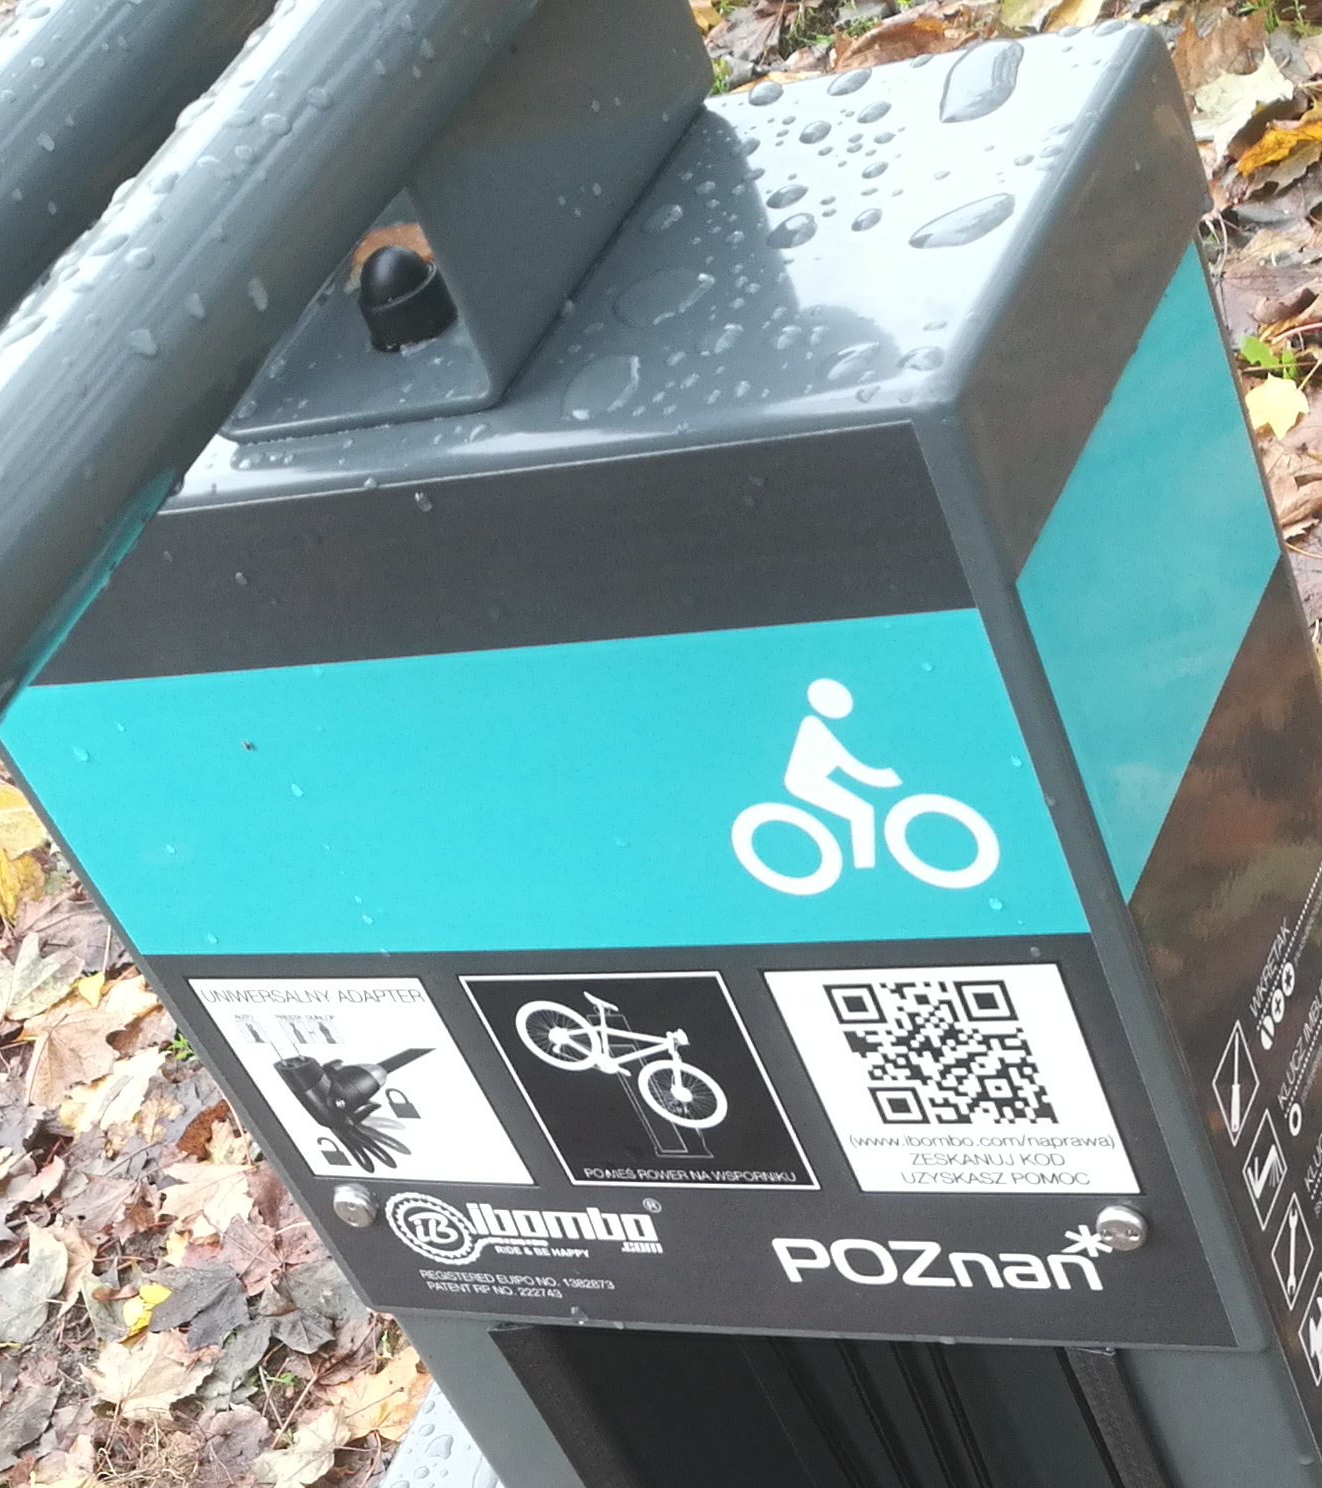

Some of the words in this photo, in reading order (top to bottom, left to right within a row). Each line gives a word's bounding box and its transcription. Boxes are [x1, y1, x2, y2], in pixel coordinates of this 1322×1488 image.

[1249, 918, 1289, 1016] WKRĘTAK
[201, 988, 331, 1003] UNIWERSALNY
[337, 989, 426, 1003] ADAPTER
[1277, 1037, 1305, 1108] KLUCZ
[849, 1134, 1116, 1149] (www.ibombo.com/naprawa)
[908, 1153, 1016, 1166] ZESKANUJ
[1021, 1153, 1065, 1166] KOD
[637, 1169, 689, 1180] ROWER
[690, 1170, 711, 1181] NA
[711, 1170, 797, 1182] WSPORNIKU
[900, 1172, 1009, 1185] UZYSKASZ
[1011, 1172, 1091, 1185] POMOC
[495, 1245, 522, 1255] RIDE
[535, 1247, 550, 1256] BE
[550, 1248, 589, 1258] HAPPY
[419, 1269, 495, 1284] REGISTERED
[535, 1276, 560, 1287] NO.
[427, 1281, 472, 1293] PATENT
[473, 1284, 491, 1294] RP
[493, 1285, 517, 1296] NO.
[517, 1287, 563, 1299] 222743
